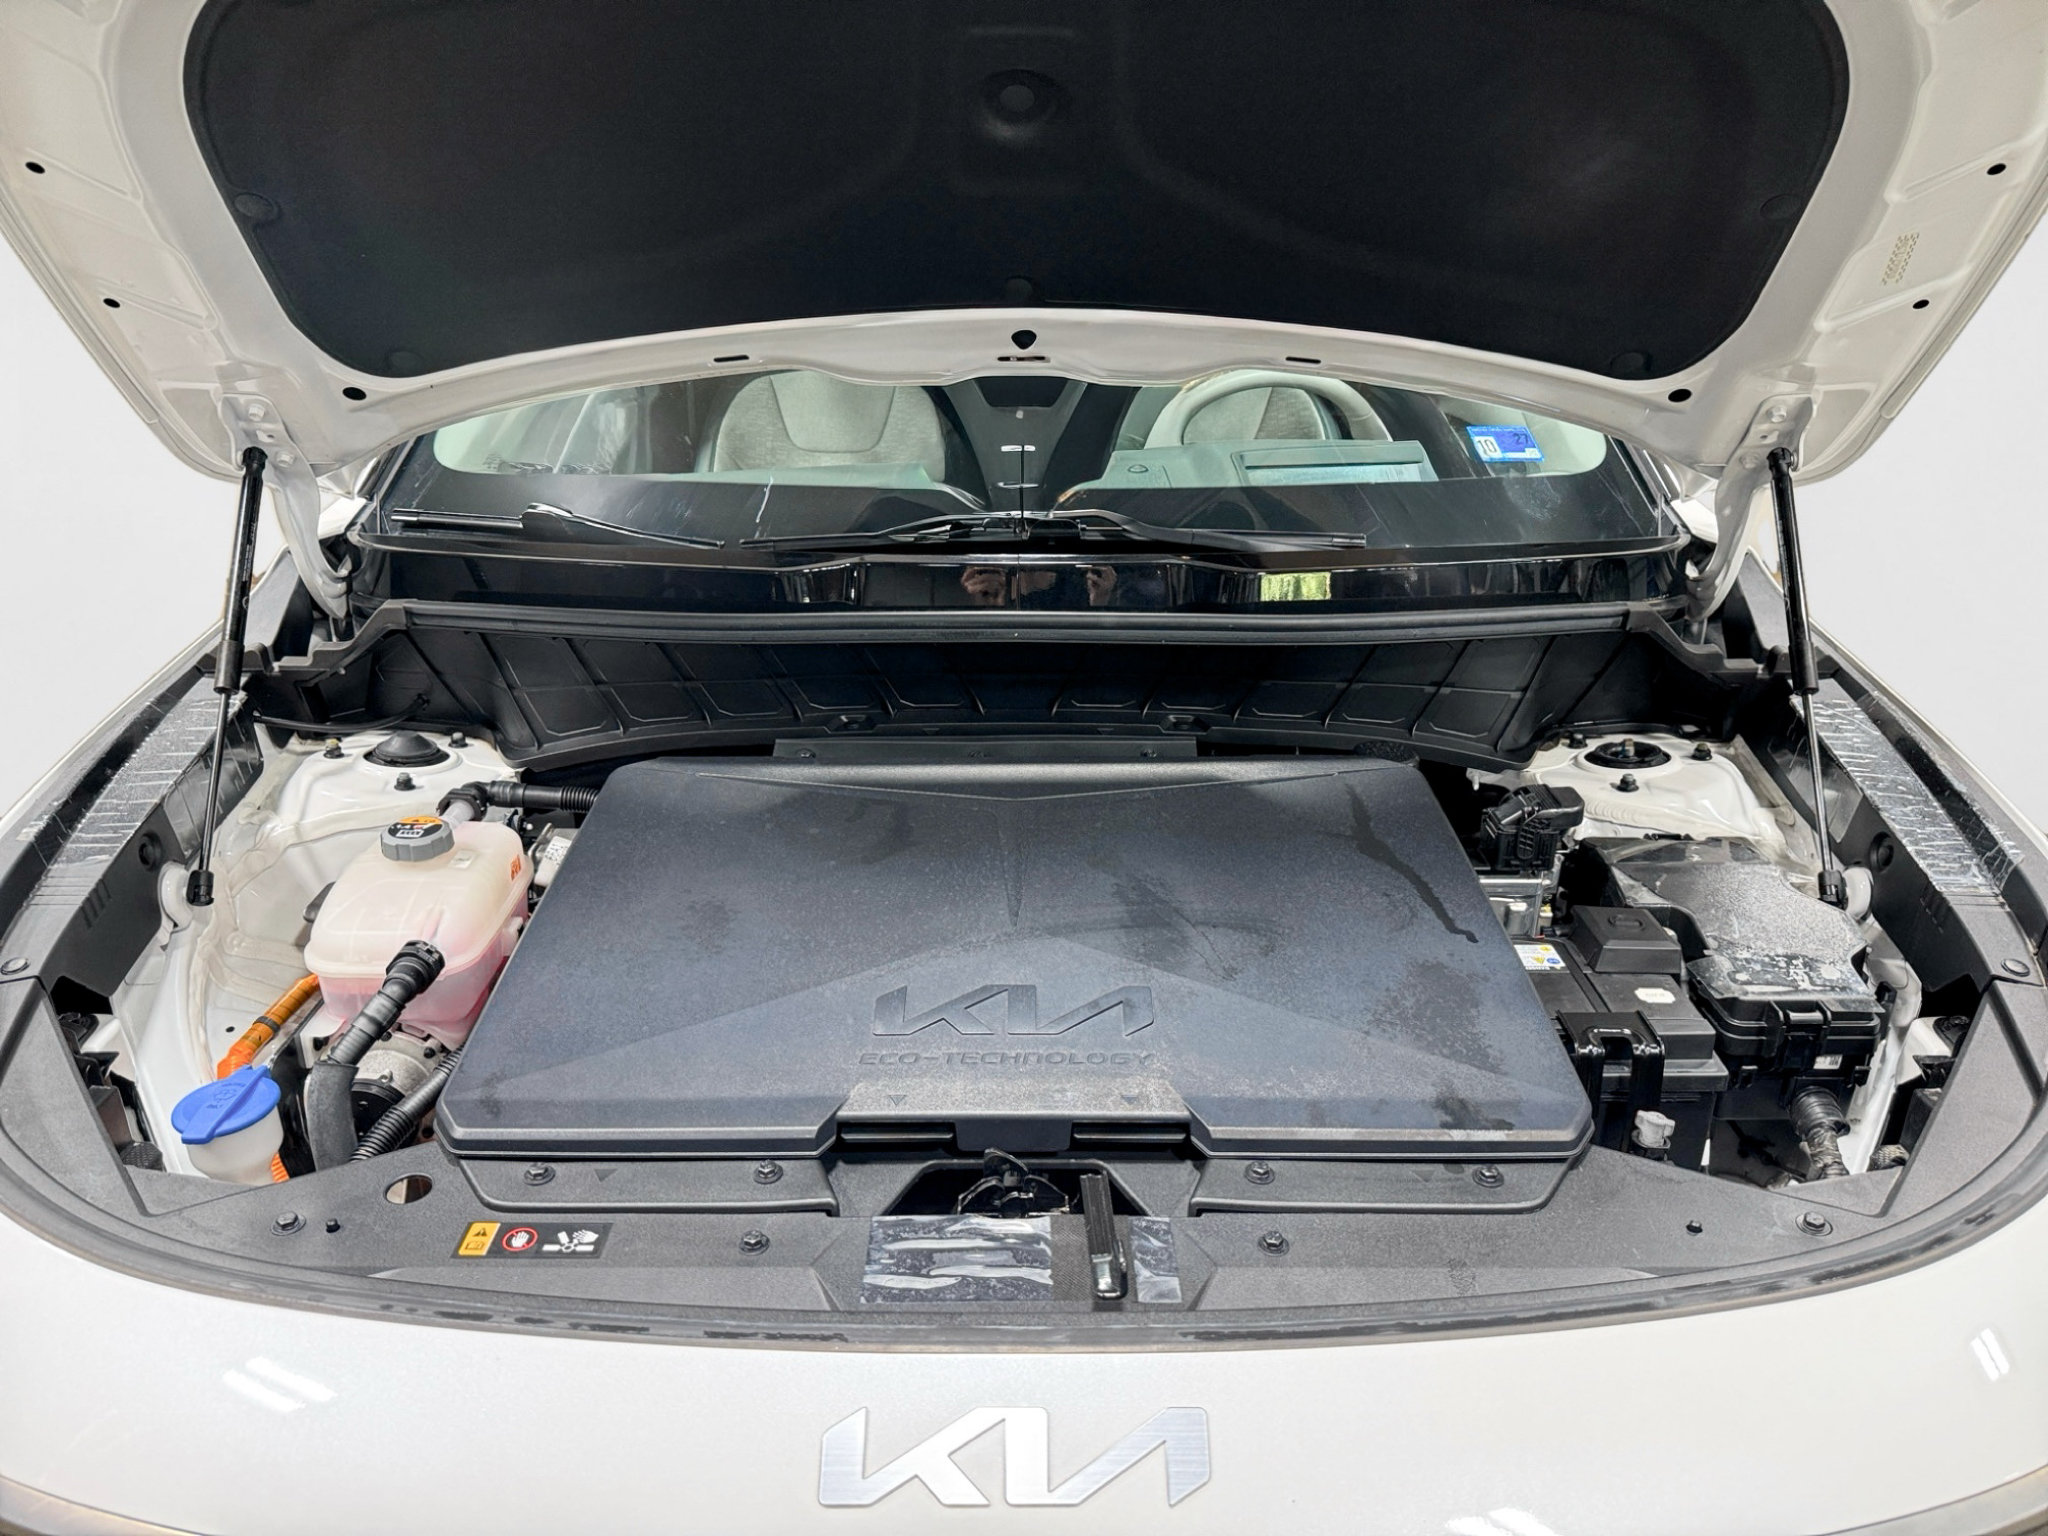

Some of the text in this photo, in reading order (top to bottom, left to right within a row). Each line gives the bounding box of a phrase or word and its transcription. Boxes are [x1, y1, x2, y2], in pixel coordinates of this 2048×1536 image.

[1477, 439, 1498, 456] 10
[872, 984, 1155, 1036] KIA
[858, 1051, 1157, 1066] ECO-TECHNOLOGY
[818, 1406, 1211, 1507] KIA
